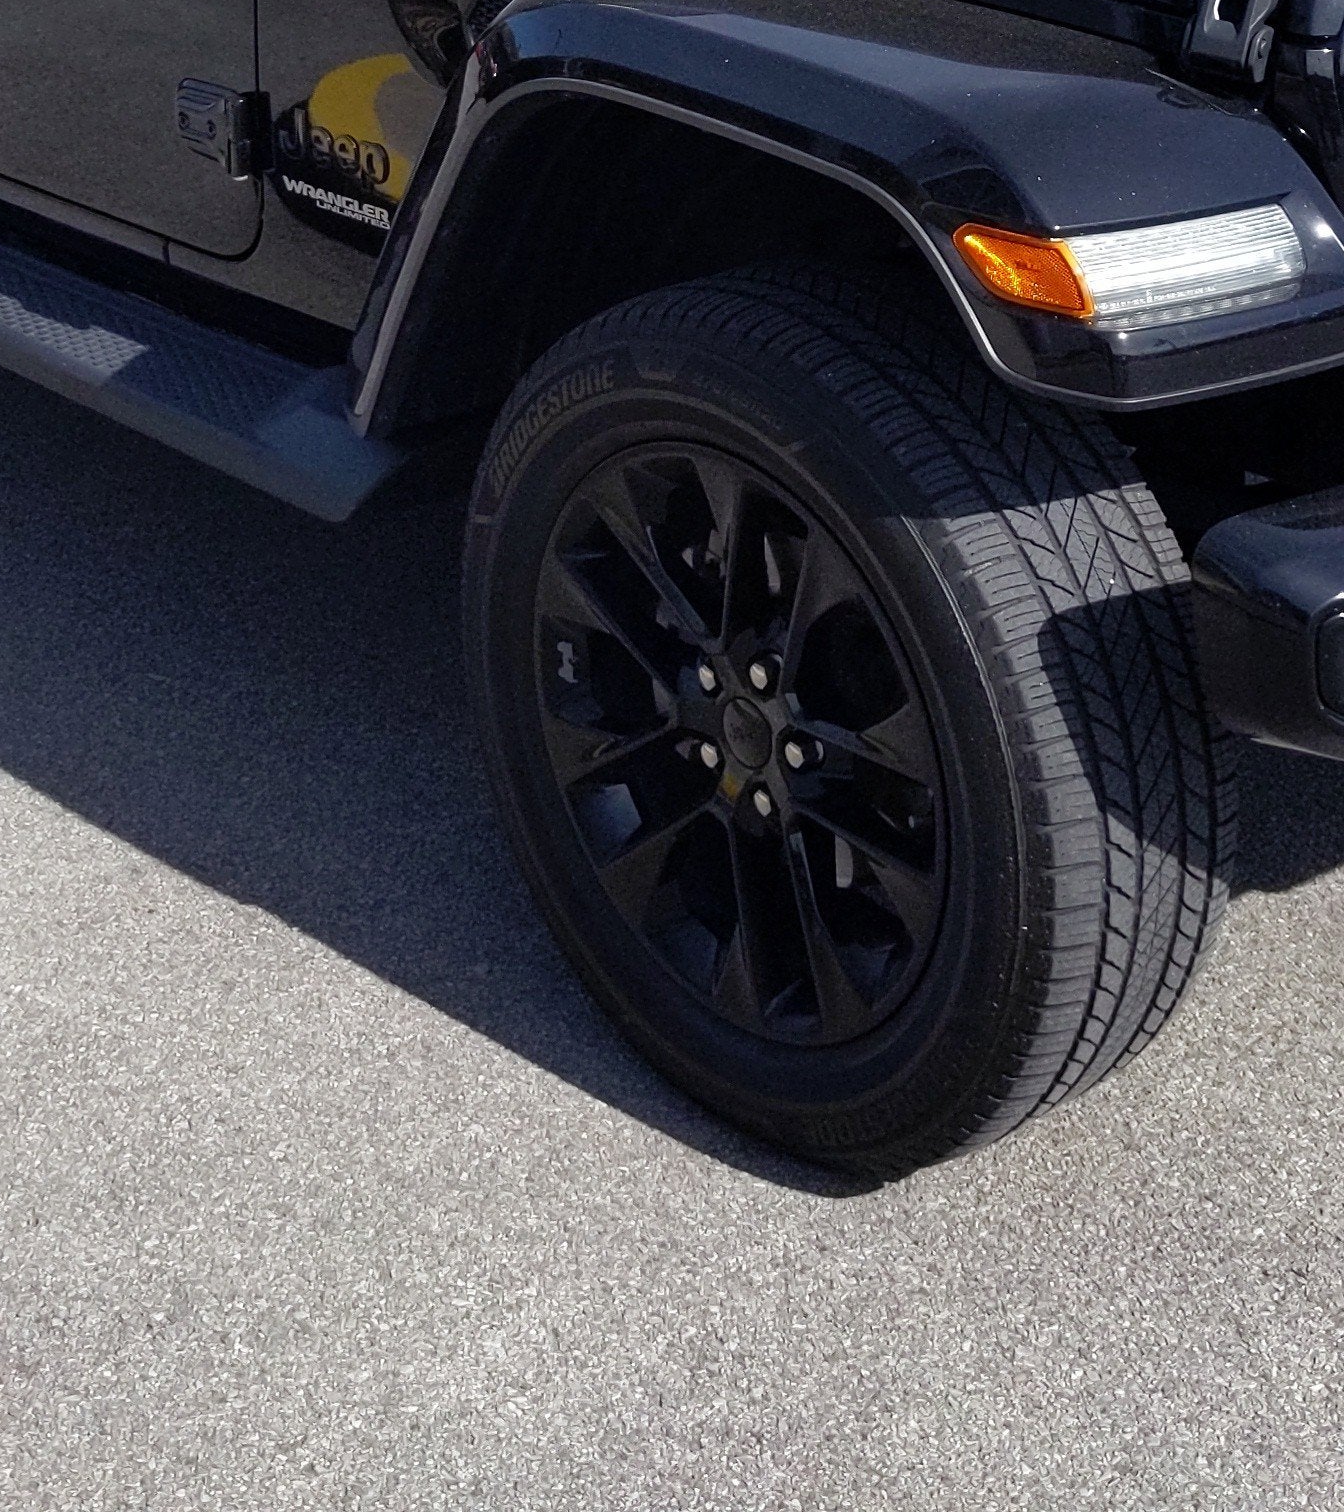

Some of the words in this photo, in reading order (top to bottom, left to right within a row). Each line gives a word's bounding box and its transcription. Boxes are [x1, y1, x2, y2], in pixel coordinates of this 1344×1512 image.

[278, 107, 390, 191] Jeep
[282, 175, 390, 223] WRANGLER
[316, 199, 391, 230] UNLIMITED
